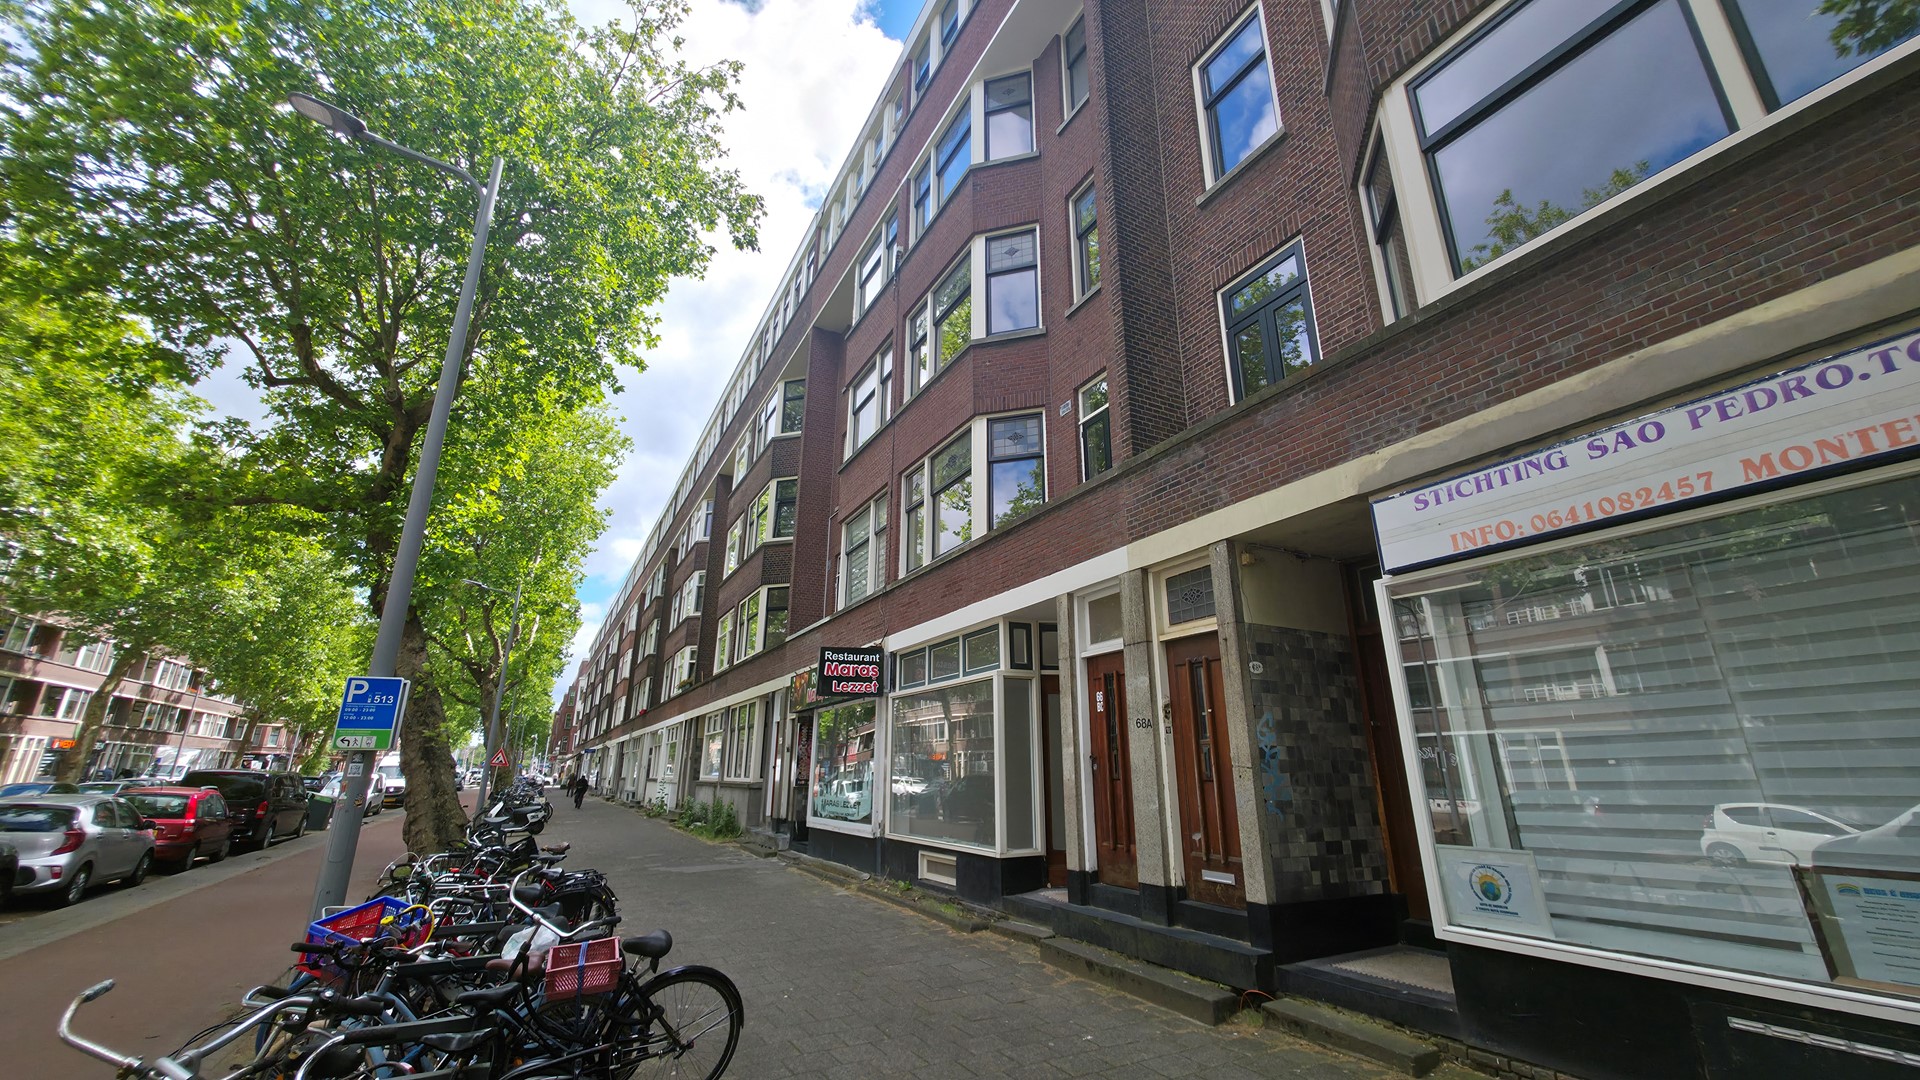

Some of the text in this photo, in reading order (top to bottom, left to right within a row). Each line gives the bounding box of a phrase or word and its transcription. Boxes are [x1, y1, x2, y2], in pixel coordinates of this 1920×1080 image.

[1413, 450, 1569, 512] STICHTING
[1586, 421, 1665, 461] SAO
[1531, 471, 1714, 534] 0641082457
[1740, 413, 1920, 483] MONTE
[825, 651, 880, 662] Restaurant
[824, 662, 879, 680] Maraş
[346, 680, 394, 703] P 513
[832, 680, 879, 693] Lezzet
[1135, 718, 1153, 729] 68A
